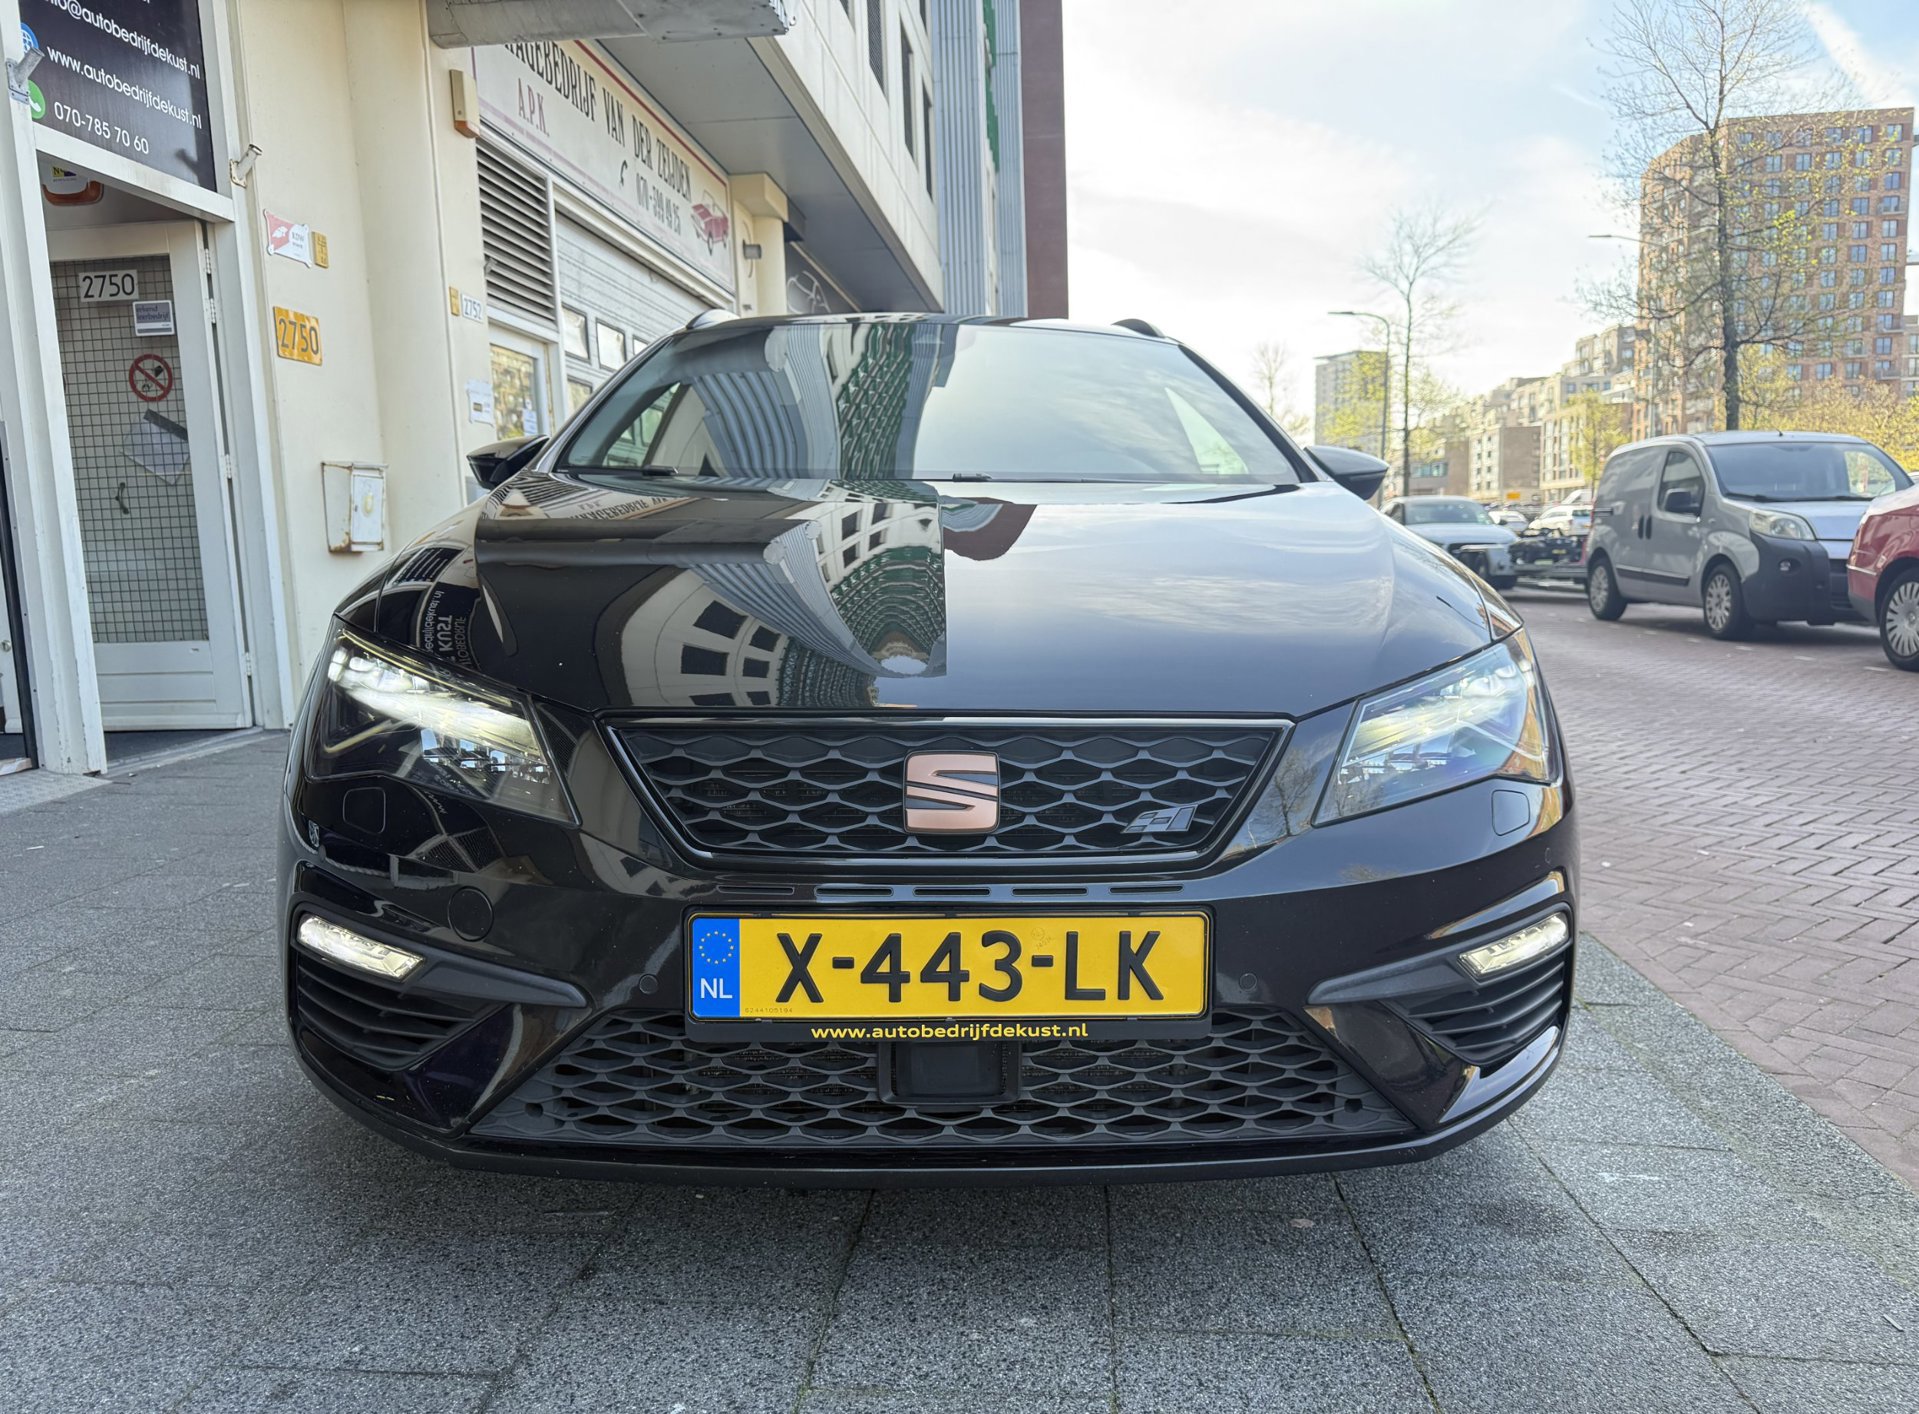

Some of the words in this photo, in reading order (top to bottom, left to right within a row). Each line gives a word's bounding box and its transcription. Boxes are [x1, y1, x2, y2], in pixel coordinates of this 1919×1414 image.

[45, 0, 200, 79] o@autobedrijfdekust.nl
[47, 46, 202, 129] www.autobedrijfdekust.nl
[505, 41, 596, 122] GEBEDRIJF
[602, 87, 625, 147] VAN
[632, 114, 653, 170] DER
[54, 101, 110, 139] 070-785
[115, 127, 130, 147] 70
[134, 135, 149, 154] 60
[82, 273, 135, 298] 2750
[279, 318, 319, 355] 2750
[700, 977, 733, 999] NL
[776, 930, 1165, 1004] X-443-LK
[811, 1022, 1090, 1041] www.autobedrijfdekust.nl
